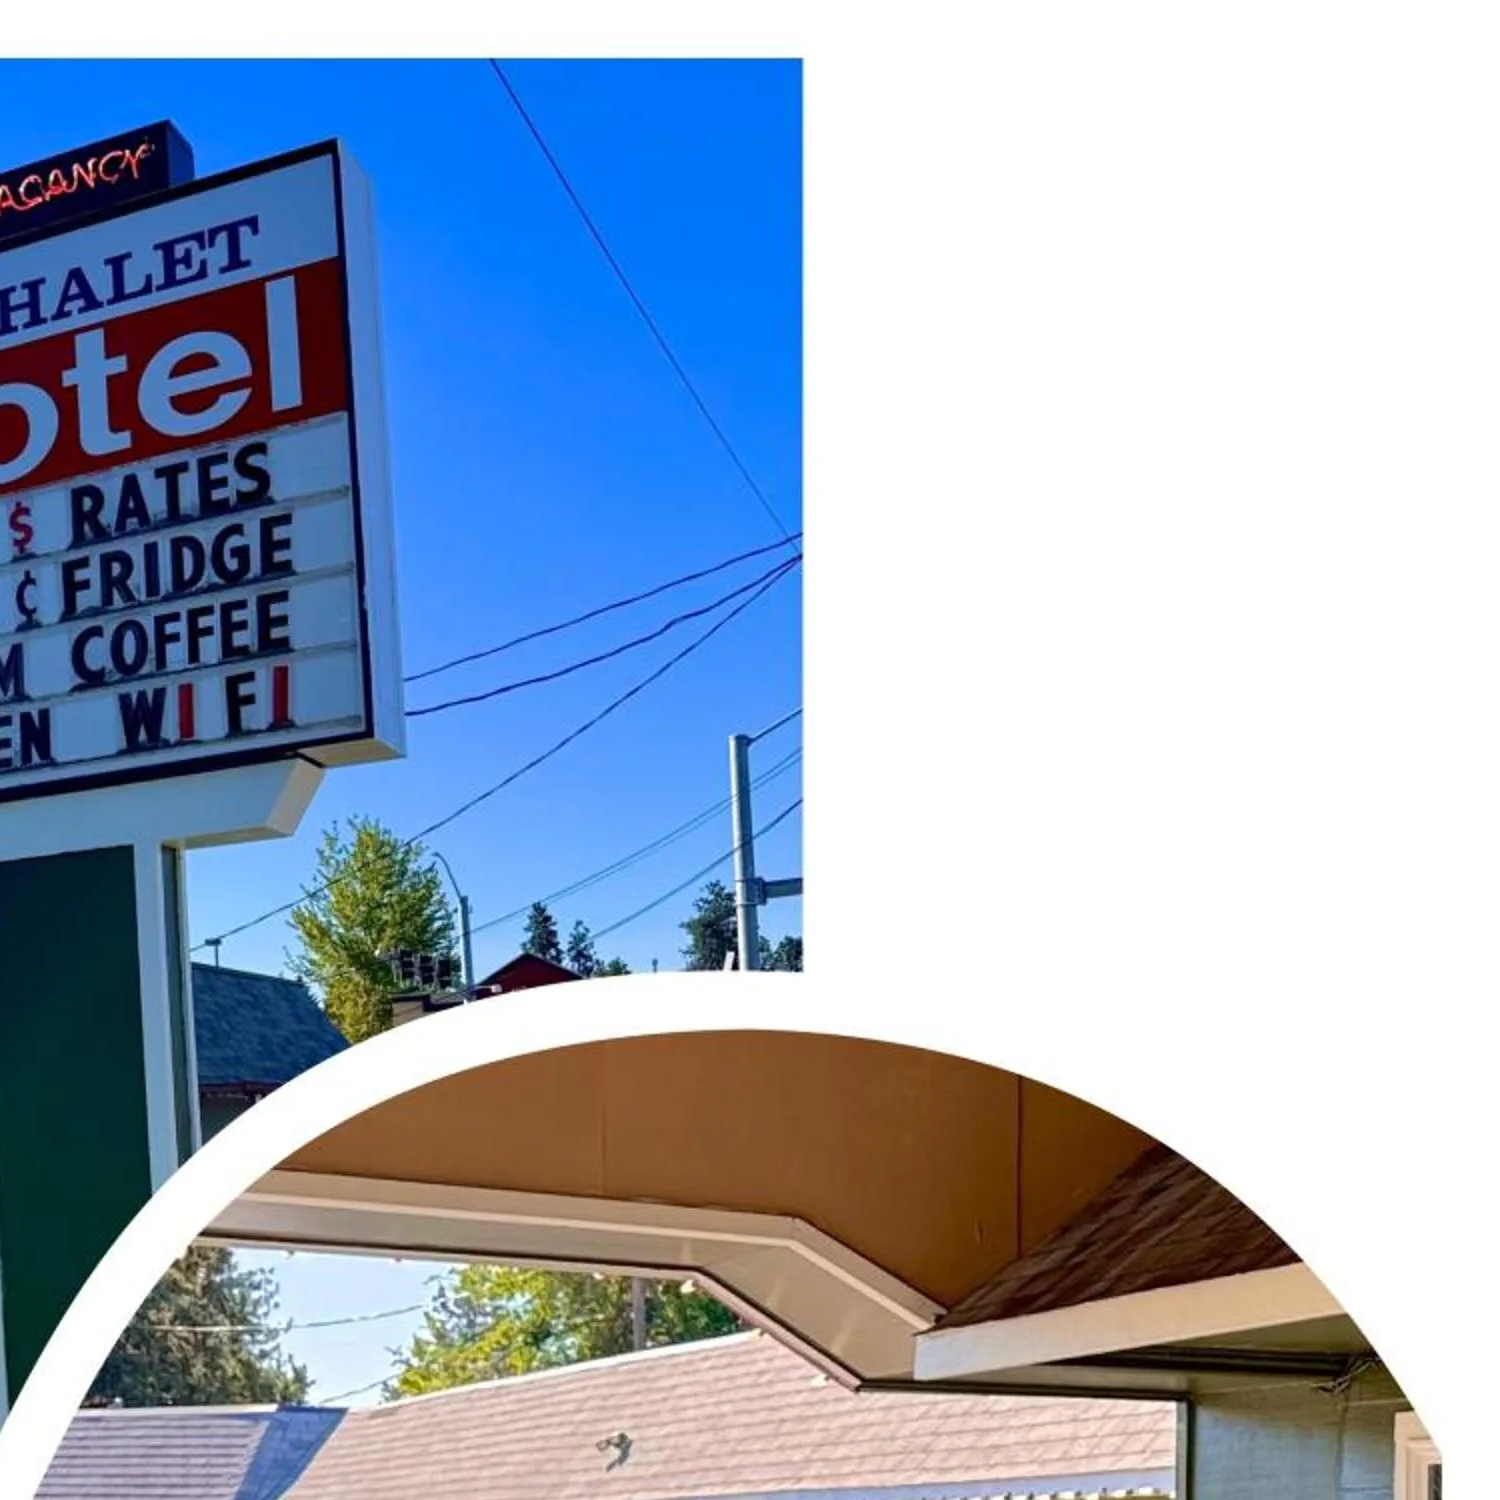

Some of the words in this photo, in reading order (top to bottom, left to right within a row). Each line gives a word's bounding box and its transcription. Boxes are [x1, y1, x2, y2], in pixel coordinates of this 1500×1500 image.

[9, 501, 34, 554] $
[70, 441, 271, 546] RATES
[60, 512, 294, 620] FRIDGE
[71, 590, 290, 690] COFFEE
